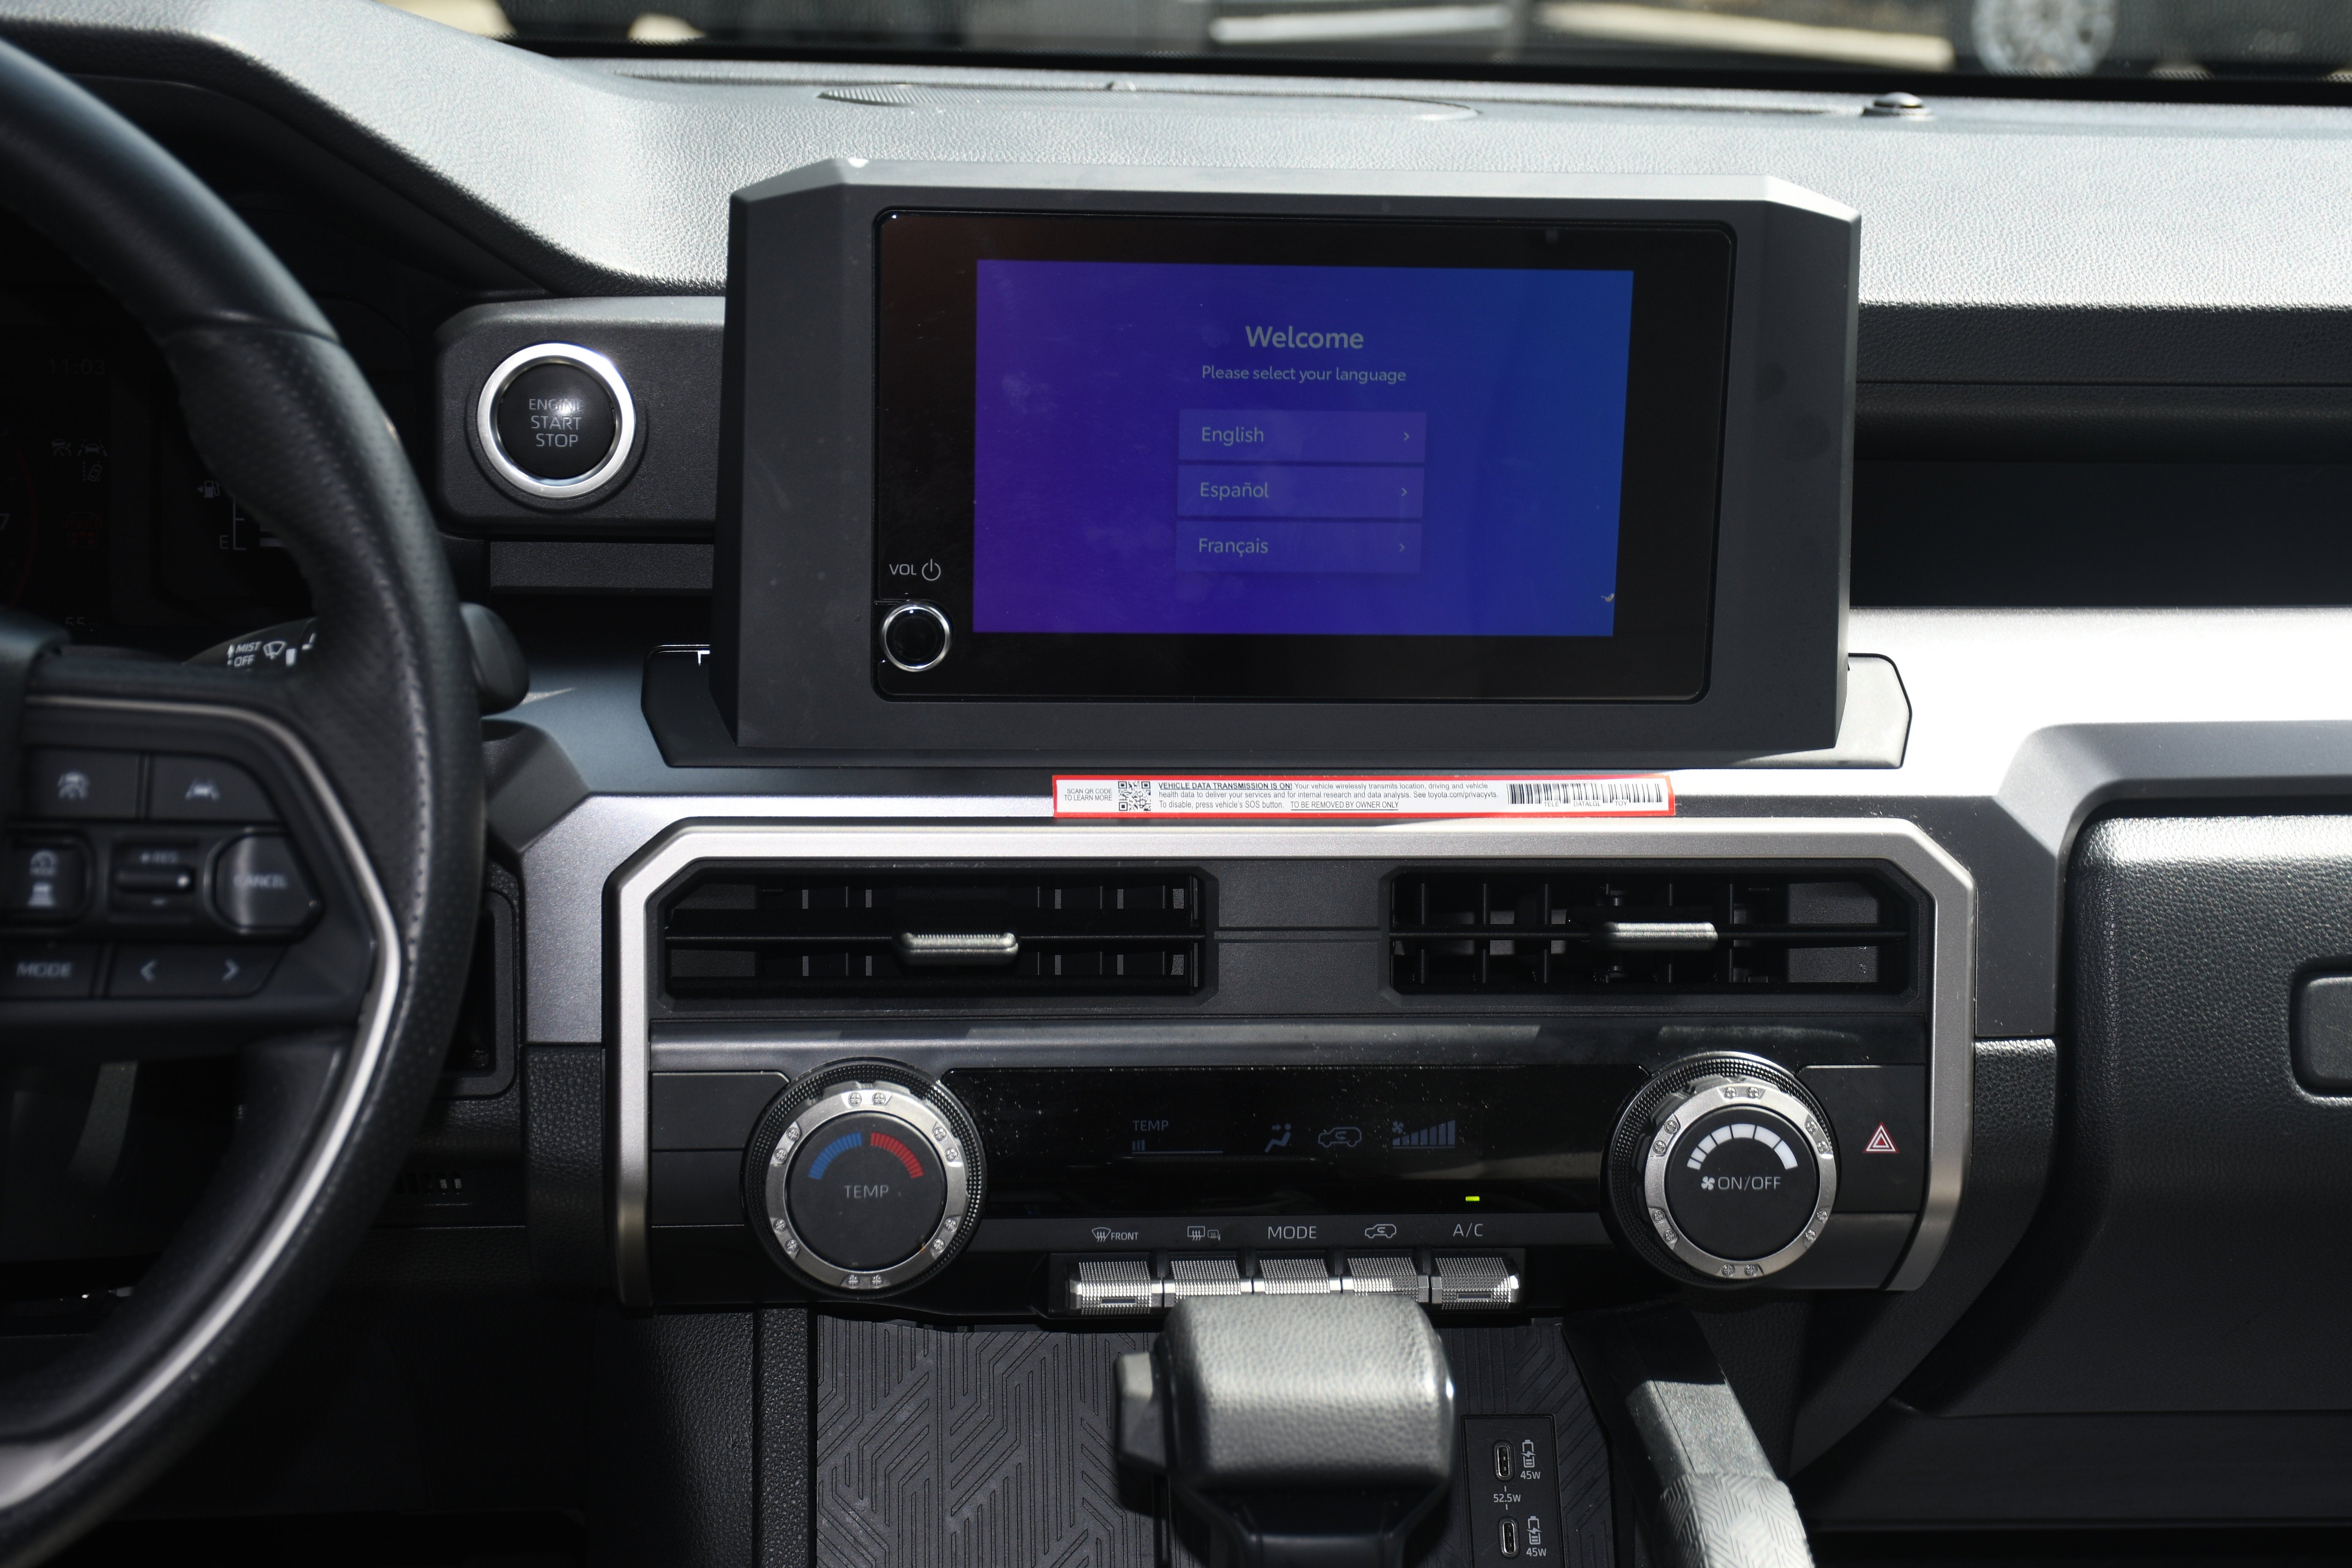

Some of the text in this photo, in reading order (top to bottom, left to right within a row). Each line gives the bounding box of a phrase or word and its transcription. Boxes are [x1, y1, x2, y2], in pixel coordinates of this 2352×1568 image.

[1245, 325, 1364, 349] Welcome
[48, 358, 106, 376] 11:03
[1202, 365, 1407, 385] Please select your language
[528, 398, 583, 411] ENGINE
[531, 415, 582, 430] START
[536, 433, 578, 447] STOP
[1201, 426, 1264, 446] English
[1200, 481, 1269, 501] Español
[219, 534, 229, 550] E
[1198, 537, 1269, 558] Français
[889, 564, 917, 575] VOL
[235, 640, 262, 654] MIST
[234, 654, 256, 667] OFF
[1335, 782, 1367, 790] wirelessly
[1399, 782, 1426, 790] location,
[1428, 782, 1450, 790] driving
[1383, 791, 1411, 800] analysis.
[1428, 791, 1499, 800] toyota.com/privacyvts.
[1168, 800, 1194, 809] disable,
[1195, 802, 1213, 810] press
[1262, 800, 1284, 808] button.
[16, 960, 73, 978] MODE
[1132, 1119, 1170, 1132] TEMP
[1718, 1176, 1781, 1191] ON/OFF
[844, 1184, 889, 1199] TEMP
[1111, 1230, 1139, 1241] FRONT
[1268, 1226, 1317, 1239] MODE
[1452, 1222, 1484, 1239] A/C
[1519, 1470, 1541, 1480] 45W
[1493, 1493, 1521, 1503] 52.5W
[1525, 1547, 1547, 1557] 45W
